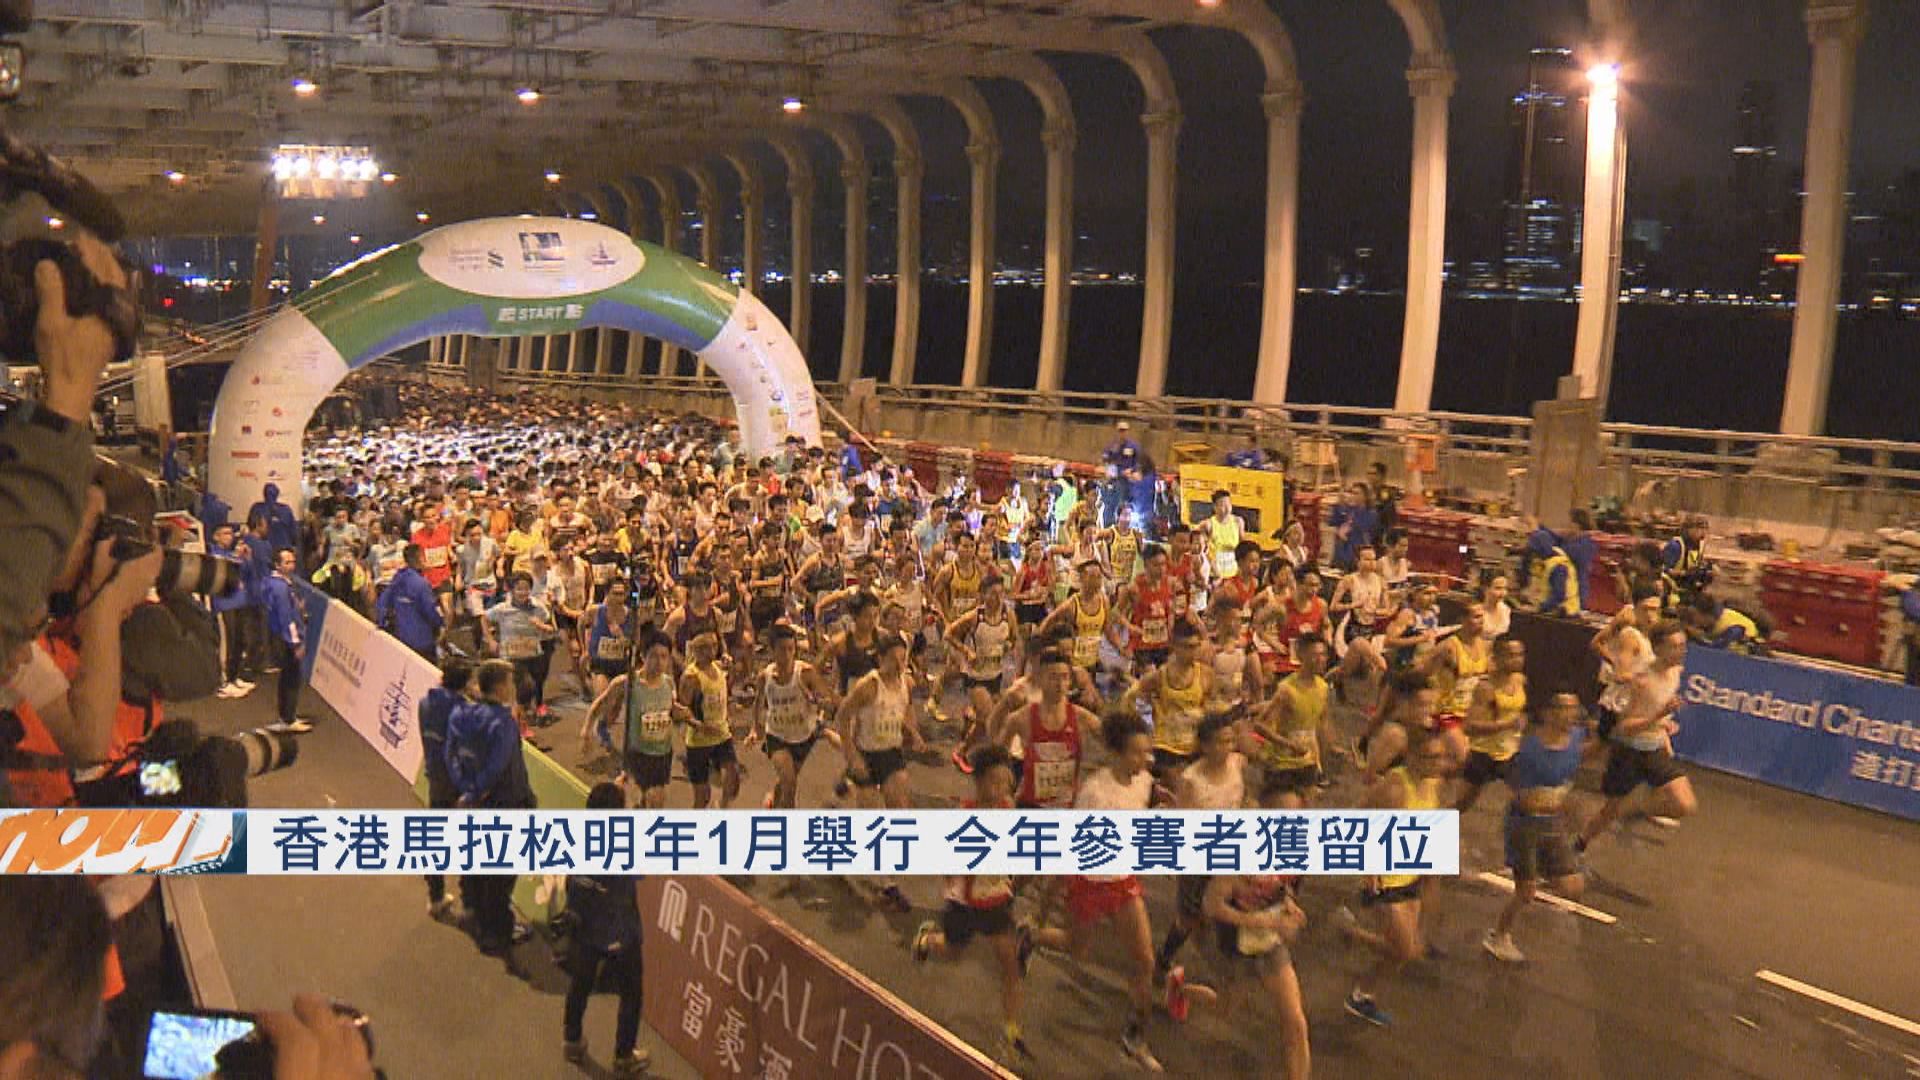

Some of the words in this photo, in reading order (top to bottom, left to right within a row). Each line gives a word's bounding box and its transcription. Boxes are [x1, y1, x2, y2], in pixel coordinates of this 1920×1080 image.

[518, 306, 564, 321] START
[1684, 674, 1822, 728] Standard
[690, 903, 817, 1052] REGAL
